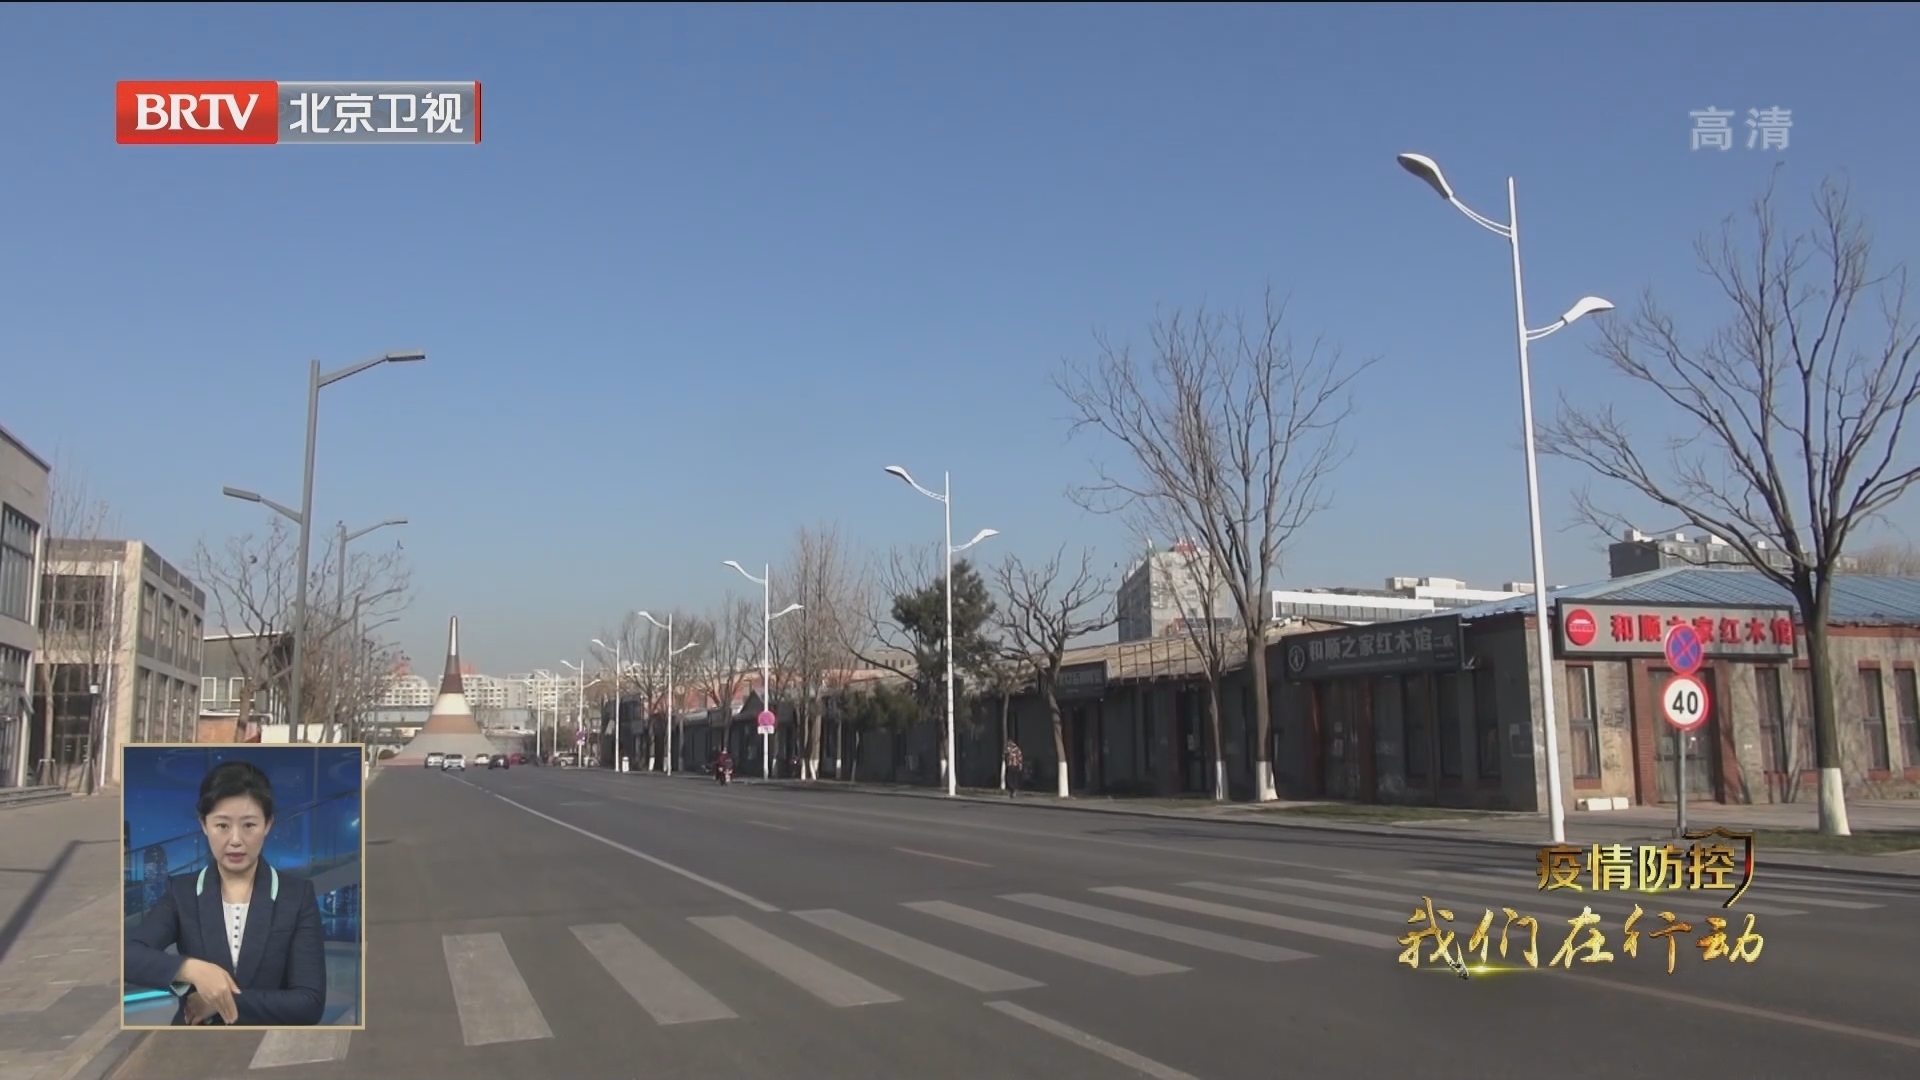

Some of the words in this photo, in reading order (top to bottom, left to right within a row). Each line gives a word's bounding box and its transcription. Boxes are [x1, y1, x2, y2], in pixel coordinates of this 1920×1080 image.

[1309, 627, 1434, 662] 和顺之家红木馆
[1672, 690, 1698, 715] 40
